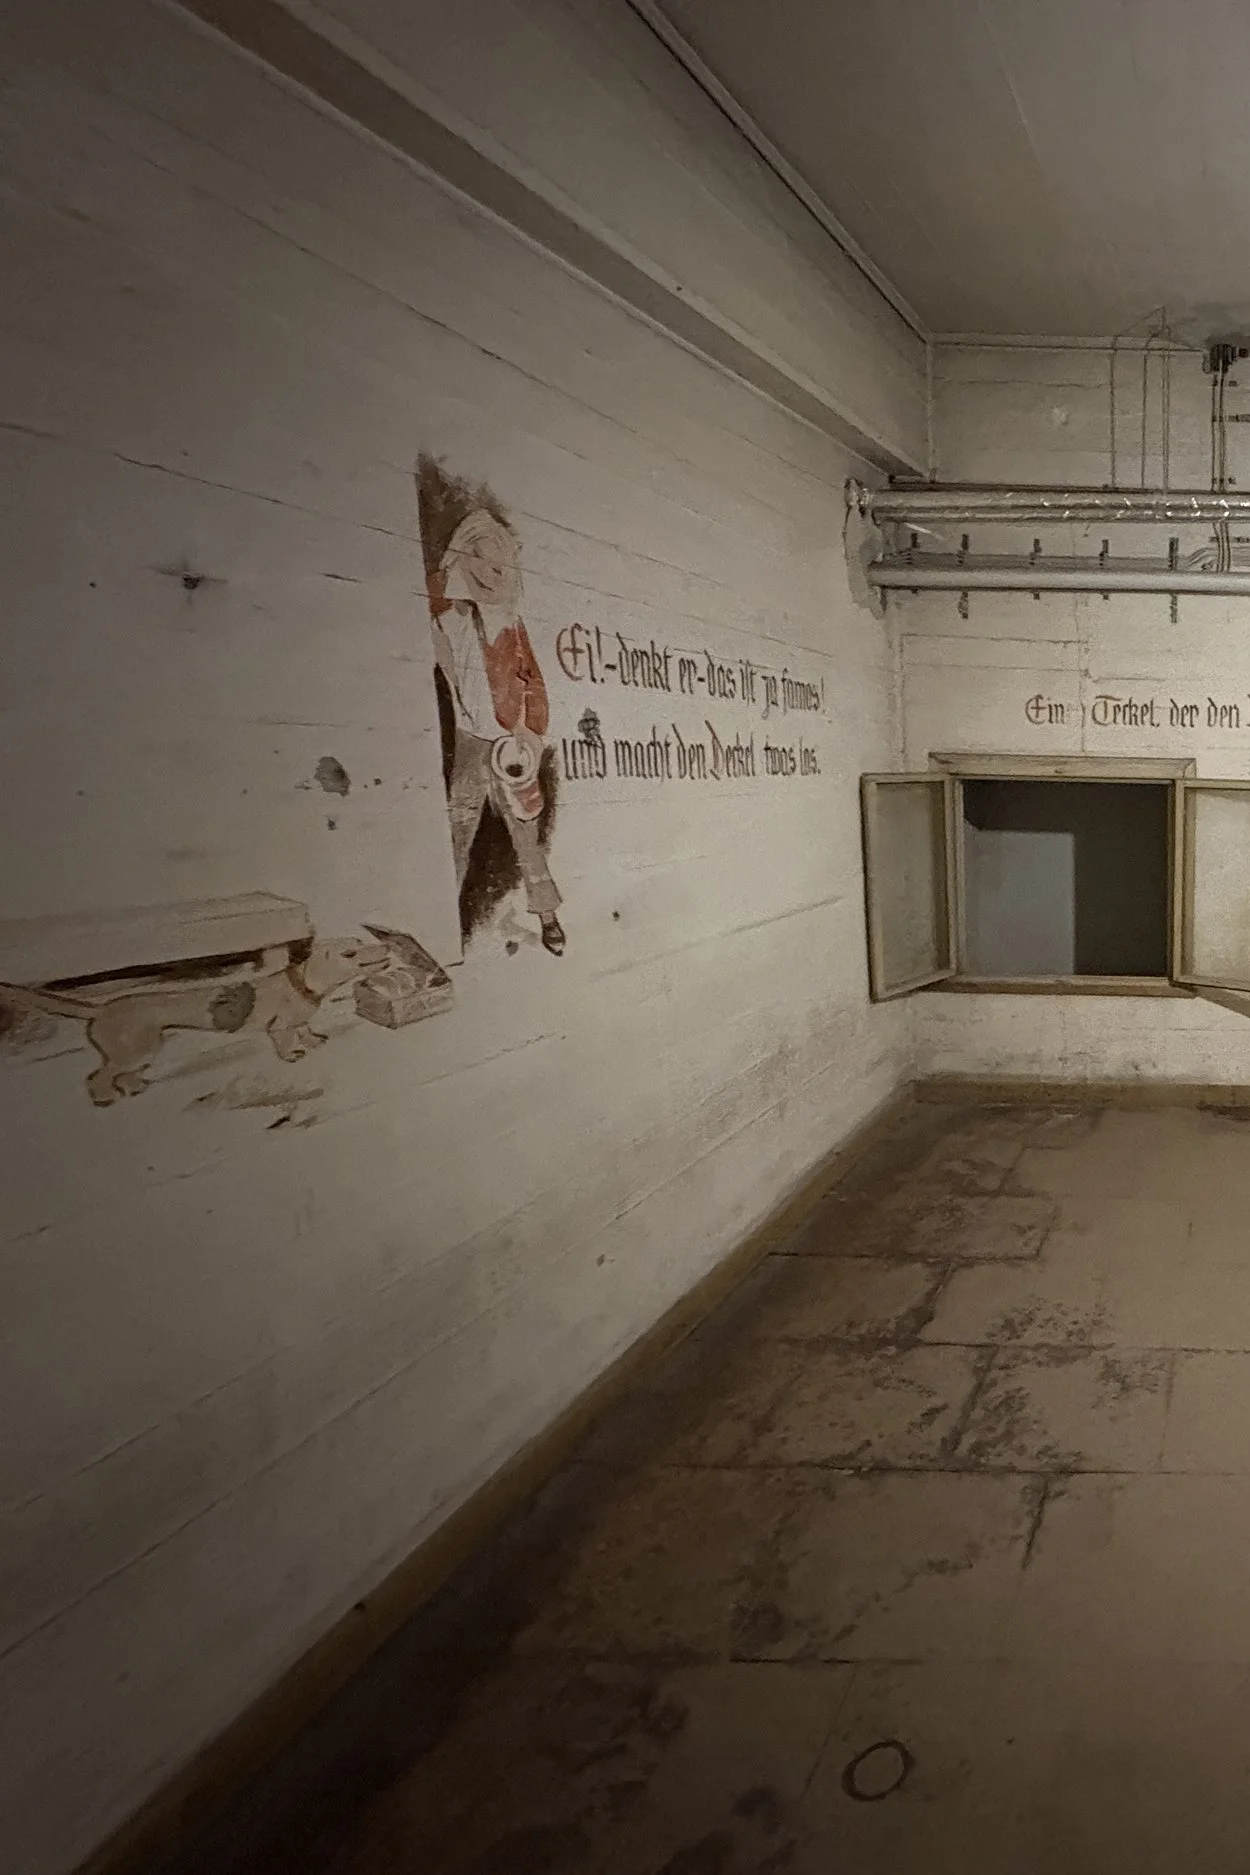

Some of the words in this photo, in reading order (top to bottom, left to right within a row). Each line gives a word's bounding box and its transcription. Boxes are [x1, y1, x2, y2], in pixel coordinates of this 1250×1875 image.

[761, 675, 779, 720] ja
[1025, 694, 1065, 725] Ein
[1169, 698, 1199, 728] der
[1207, 697, 1240, 728] den
[614, 723, 672, 783] macht
[672, 722, 706, 781] den
[705, 719, 756, 781] Deckel
[799, 735, 822, 777] los.
